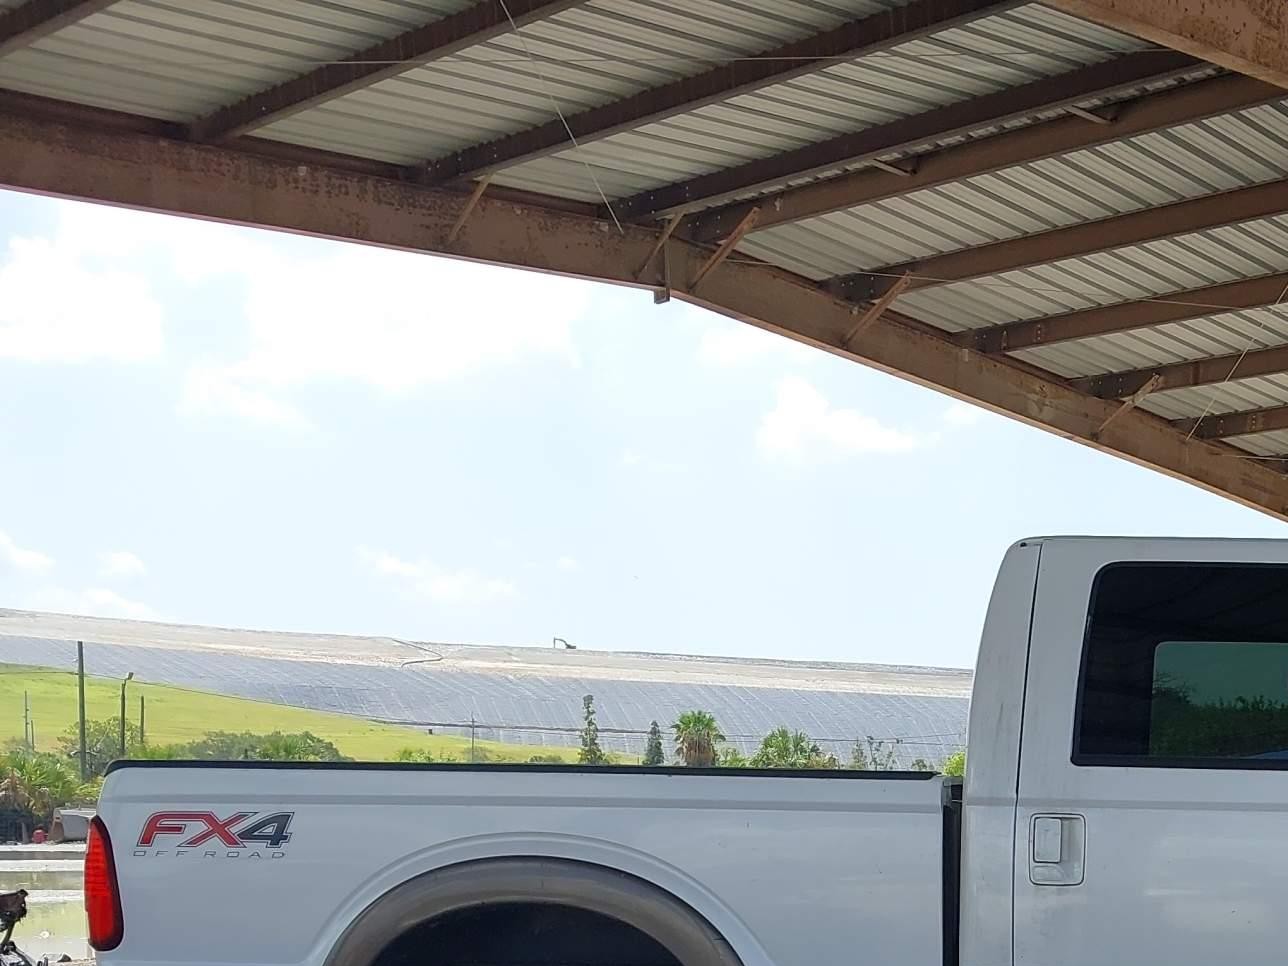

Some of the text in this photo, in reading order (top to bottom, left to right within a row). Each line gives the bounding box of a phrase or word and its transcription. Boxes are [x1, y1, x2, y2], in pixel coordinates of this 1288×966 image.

[136, 810, 295, 848] FX4
[133, 850, 286, 859] OFF ROAD
